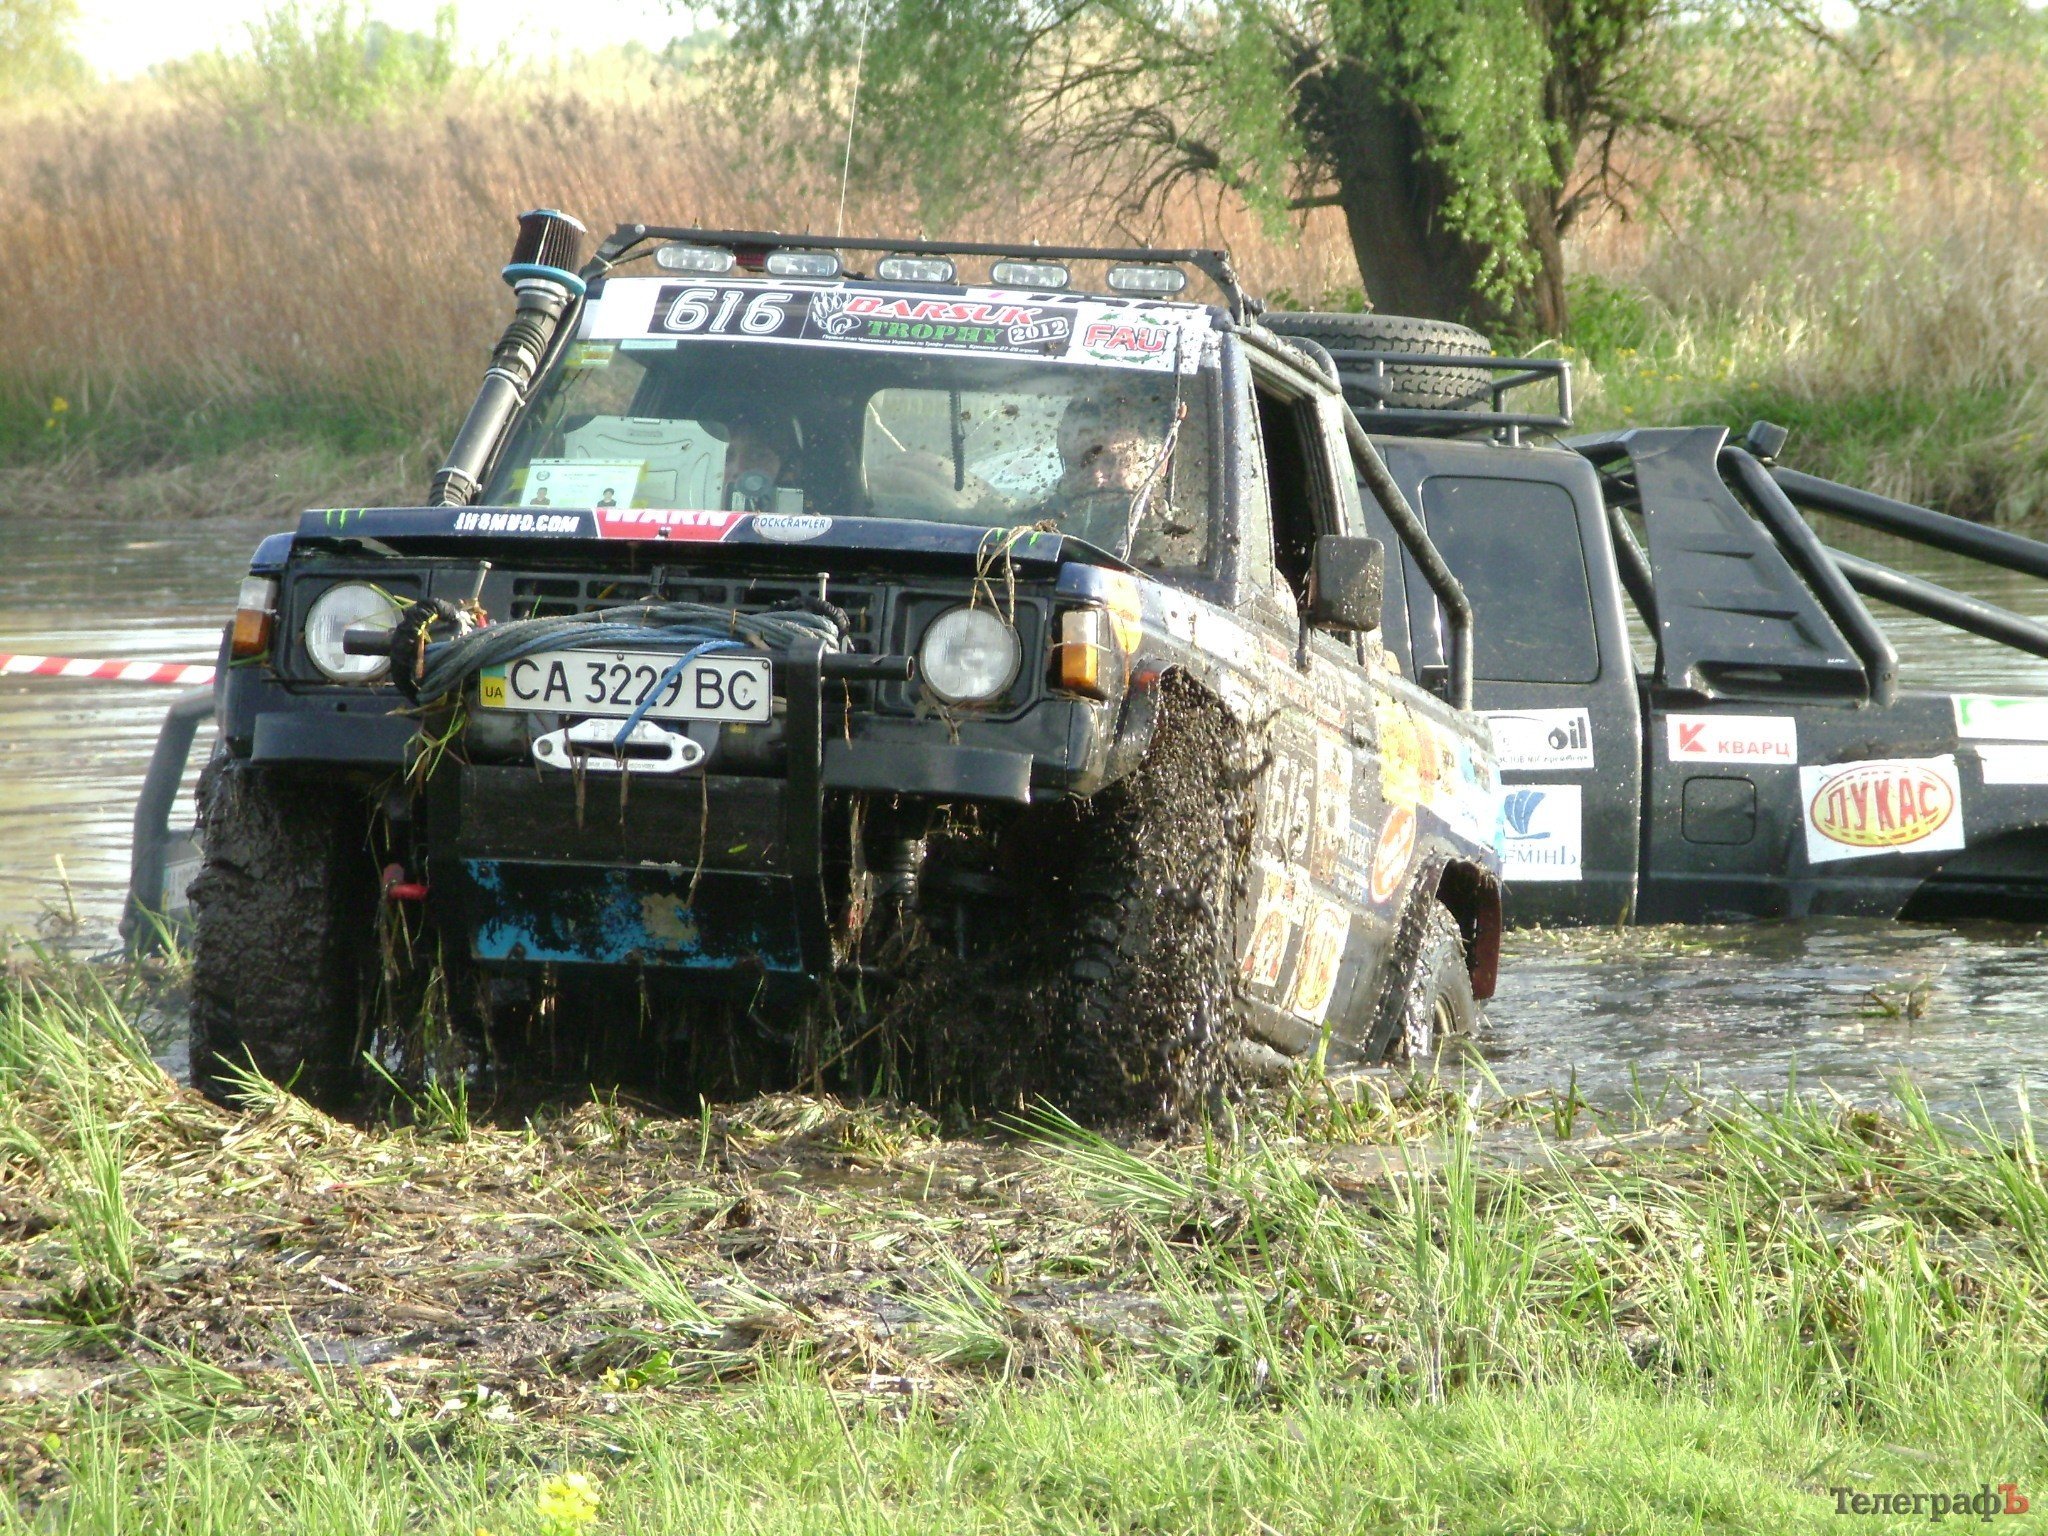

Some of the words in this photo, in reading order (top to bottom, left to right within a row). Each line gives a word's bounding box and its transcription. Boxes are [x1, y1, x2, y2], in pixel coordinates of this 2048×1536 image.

[664, 288, 793, 334] 616
[845, 296, 1042, 325] BARSUK
[868, 320, 1004, 343] TROPHY
[1011, 319, 1067, 342] 2012
[1083, 323, 1167, 352] FAU
[454, 512, 580, 532] IH8MUD.COM
[753, 516, 827, 529] ROCKCRAWLER
[485, 687, 503, 698] UA
[510, 658, 571, 702] CA
[585, 662, 683, 707] 3229
[696, 667, 757, 711] BC
[1548, 717, 1588, 750] oil
[1718, 741, 1790, 757] КВАРЦ
[1825, 778, 1939, 830] ЛУКАС
